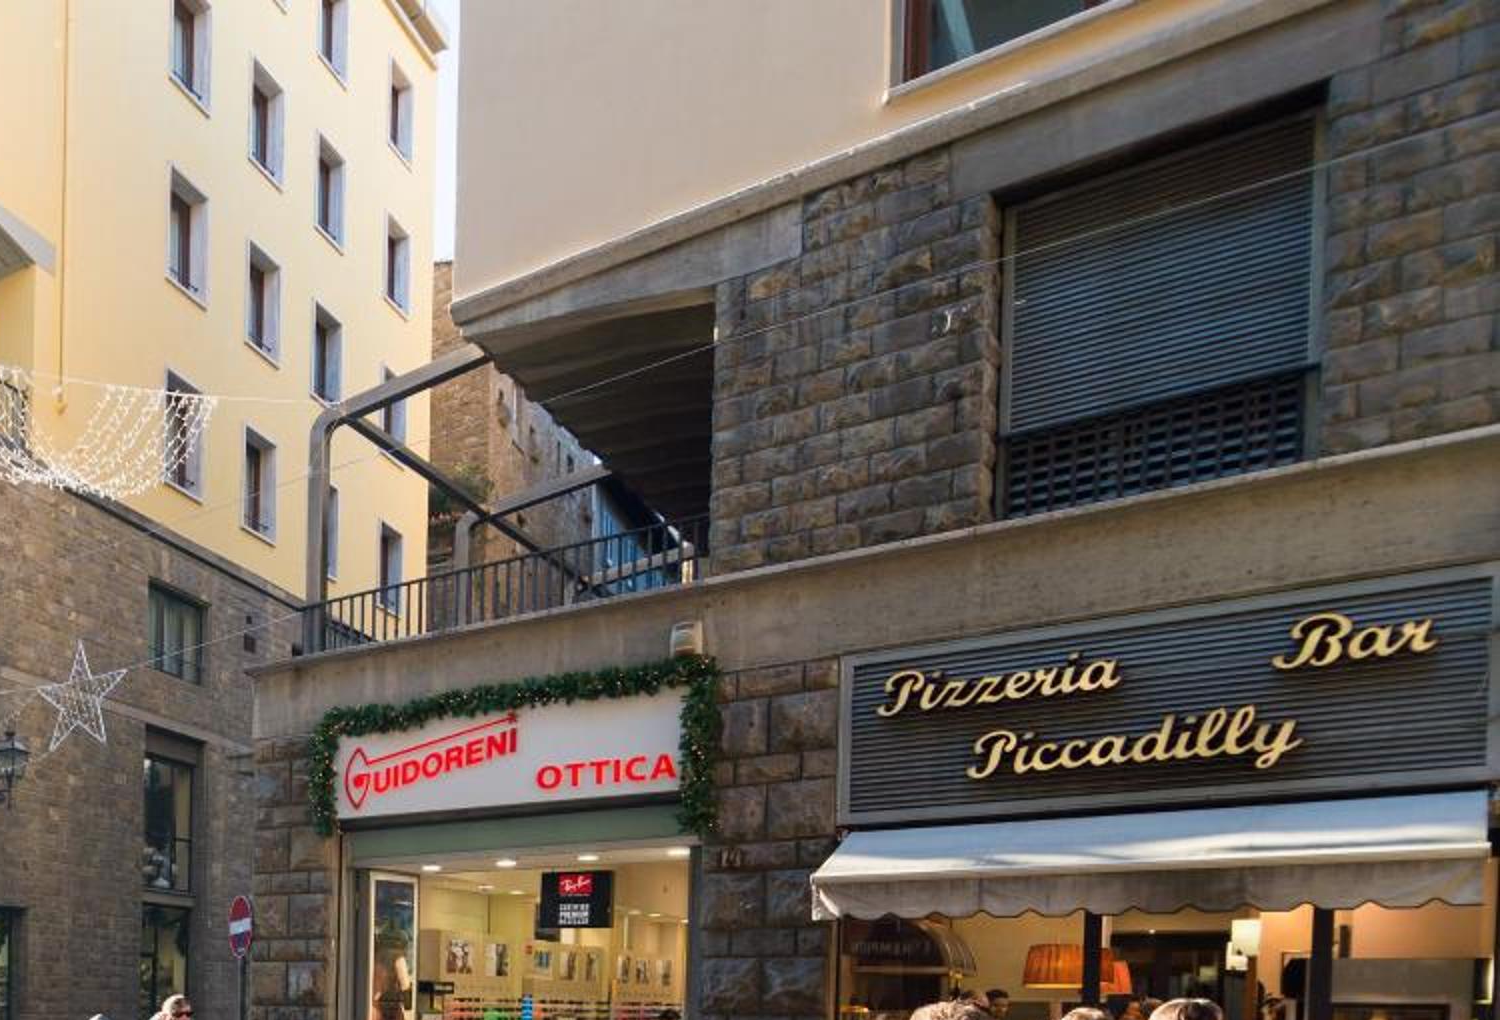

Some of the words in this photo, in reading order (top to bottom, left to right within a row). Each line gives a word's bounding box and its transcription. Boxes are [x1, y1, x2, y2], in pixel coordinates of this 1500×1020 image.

[876, 651, 1121, 717] Pizzeria
[1271, 611, 1438, 670] Bar
[536, 753, 676, 791] OTTICA
[965, 703, 1303, 780] Piccadilly
